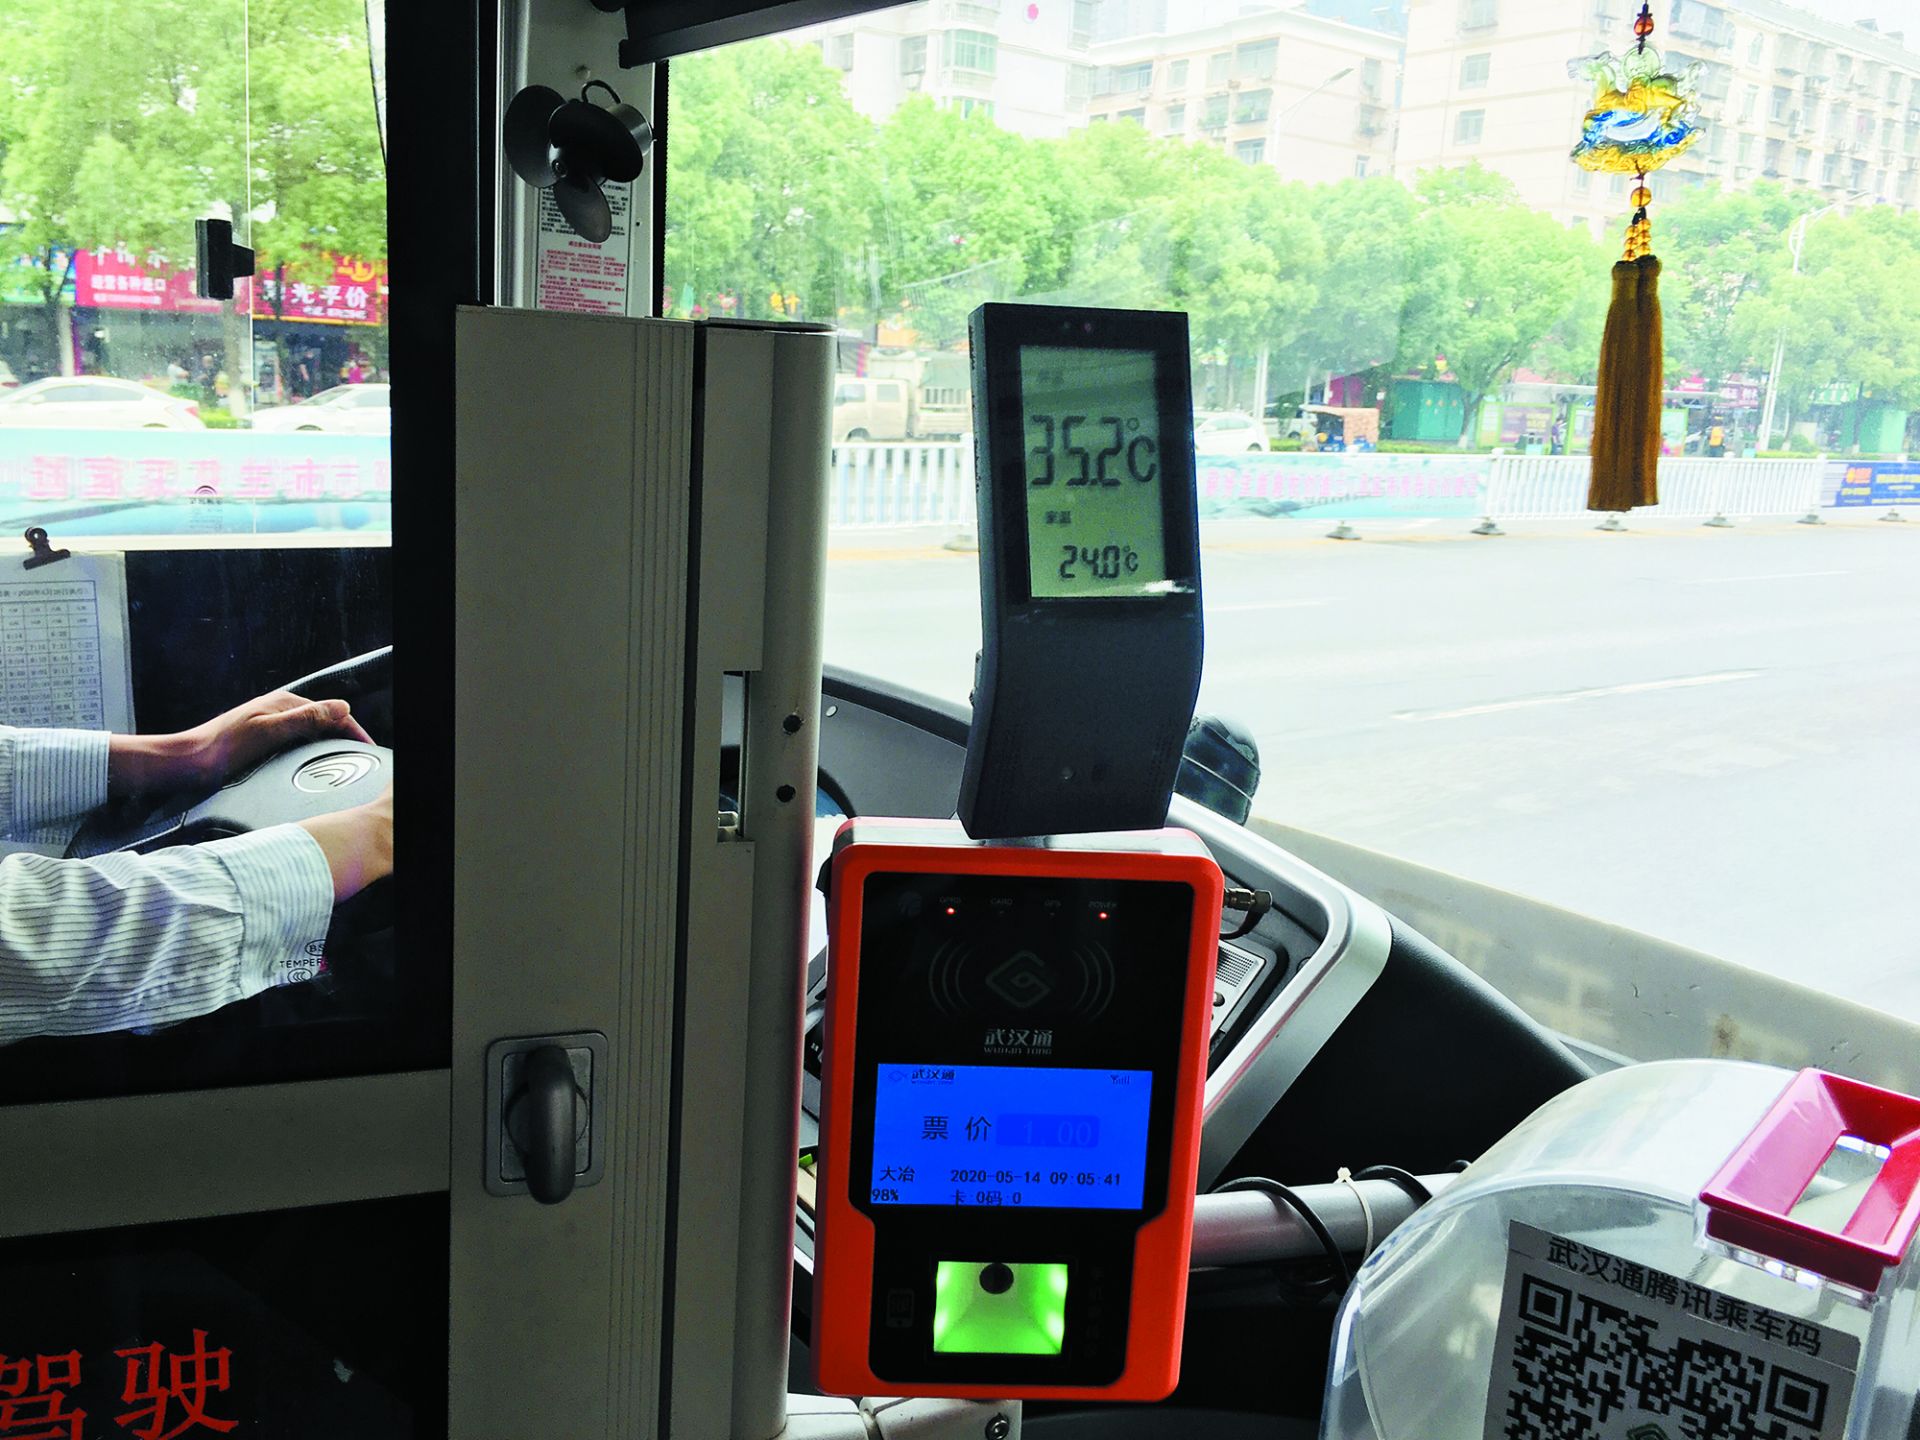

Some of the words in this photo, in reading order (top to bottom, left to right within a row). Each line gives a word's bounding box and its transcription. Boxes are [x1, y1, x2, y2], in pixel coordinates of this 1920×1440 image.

[985, 1029, 1052, 1047] 武汉通
[911, 1069, 955, 1081] 武汉通
[922, 1115, 991, 1141] 票价
[880, 1166, 915, 1182] 大冶
[951, 1169, 1040, 1184] 2020-05-14
[872, 1188, 899, 1201] 98%
[1547, 1235, 1822, 1357] 武汉通腾讯乘车码
